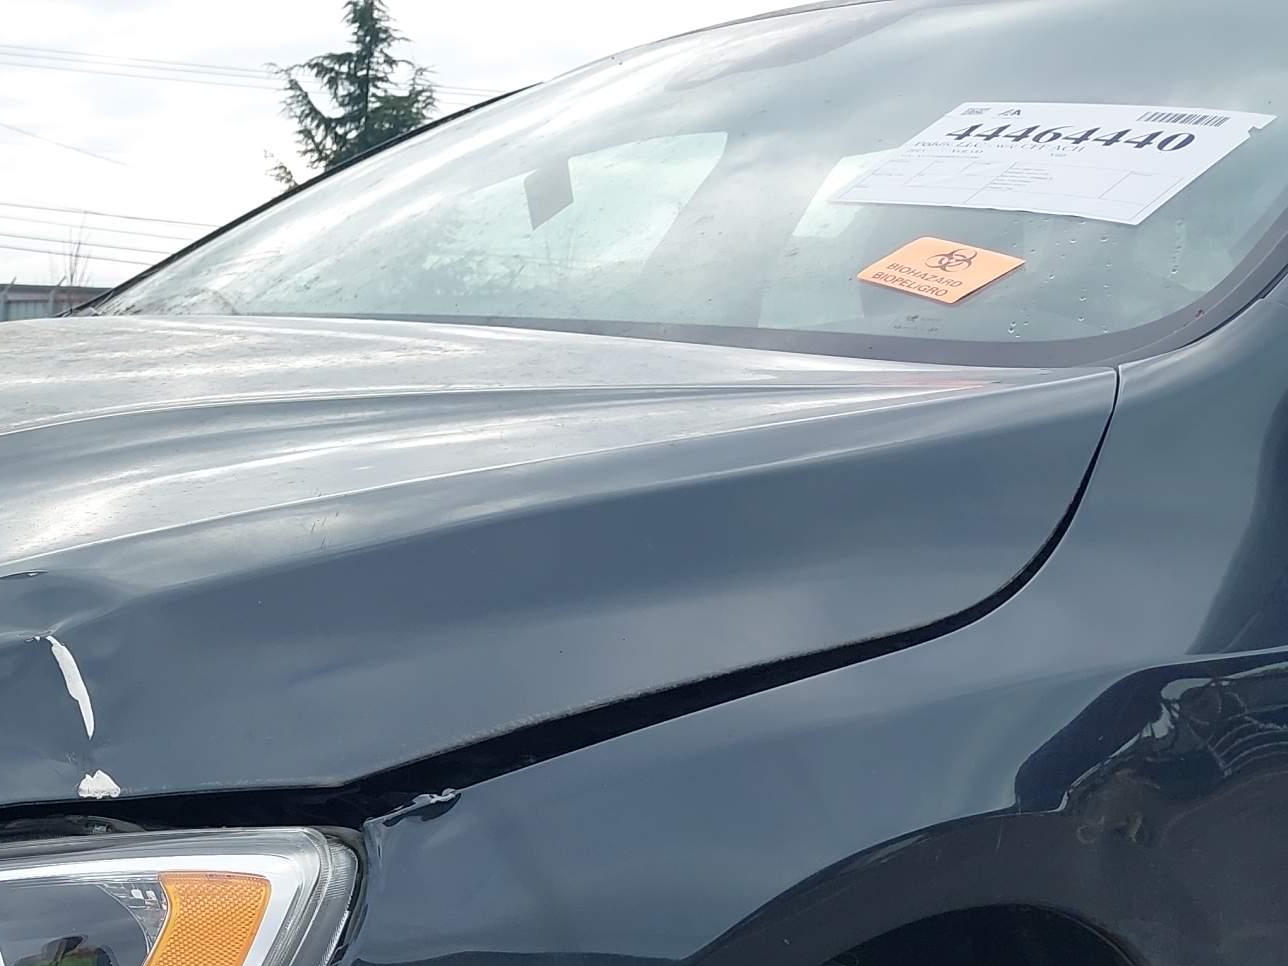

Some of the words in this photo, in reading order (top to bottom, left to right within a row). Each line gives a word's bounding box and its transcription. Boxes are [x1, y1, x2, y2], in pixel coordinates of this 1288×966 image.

[945, 123, 1195, 152] 44464440
[872, 271, 949, 297] BIOPELIGRO
[887, 262, 964, 288] BIOHAZARD
